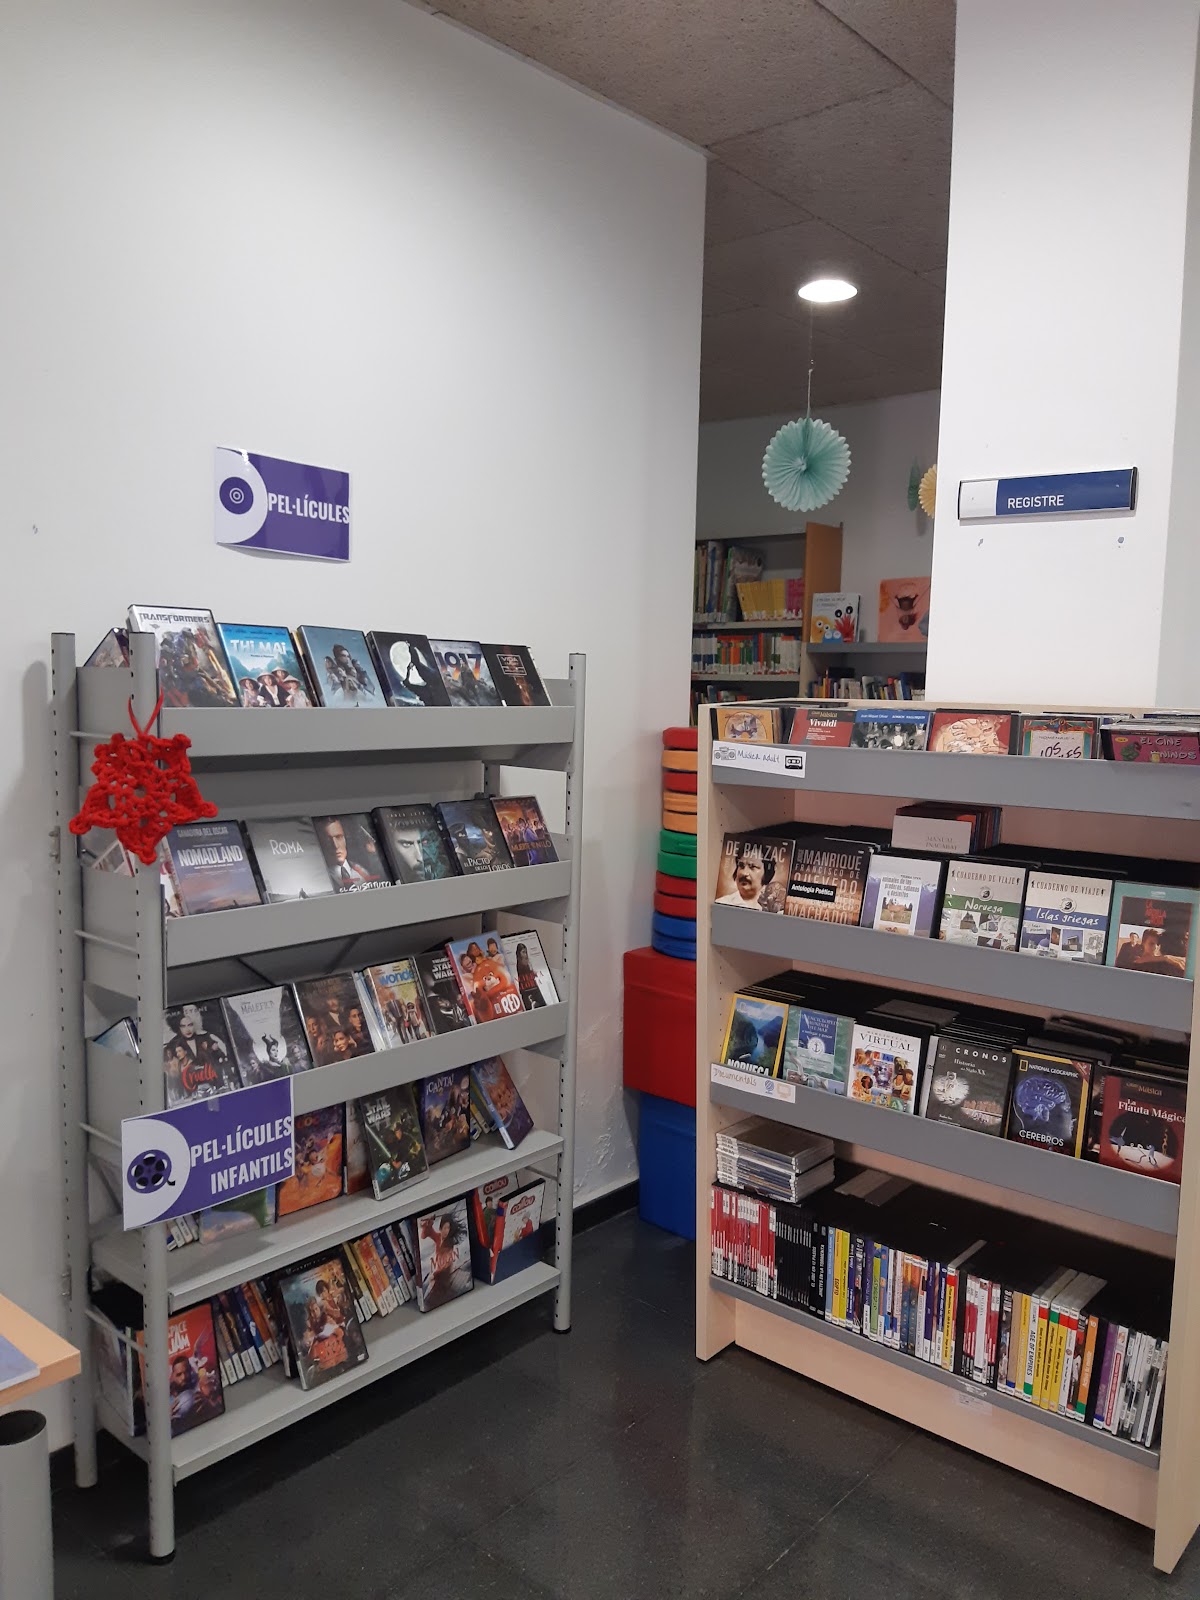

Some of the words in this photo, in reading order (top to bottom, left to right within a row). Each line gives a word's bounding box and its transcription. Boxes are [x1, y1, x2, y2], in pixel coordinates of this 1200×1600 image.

[267, 492, 349, 524] PEL·LÍCULES
[1007, 494, 1065, 509] REGISTRE
[138, 612, 210, 624] TRANSFORMERS
[434, 651, 482, 681] 1917
[810, 718, 837, 728] Vivaldi
[1140, 737, 1152, 745] EL
[1155, 737, 1181, 746] CINE
[269, 839, 305, 855] ROMA
[725, 840, 740, 857] DE
[743, 842, 787, 863] BALZAC
[177, 845, 243, 867] NOMADLAND
[467, 857, 490, 867] PACTO
[803, 849, 862, 871] MANRIQUE
[488, 863, 511, 872] LOBOS
[795, 863, 844, 877] FRANCISCO
[850, 870, 861, 879] DE
[956, 870, 986, 882] CUADERNO
[988, 875, 997, 883] DE
[998, 876, 1015, 885] VIAJE
[1036, 880, 1068, 893] CUADERNO
[1070, 885, 1079, 894] DE
[1081, 886, 1100, 896] VIAJE
[788, 903, 847, 924] MACHADO
[964, 899, 1003, 914] Noruega
[1036, 907, 1059, 922] Islas
[1062, 912, 1100, 926] griegas
[433, 970, 455, 979] WAR
[501, 993, 520, 1014] RED
[860, 1033, 914, 1052] VIRTUAL
[954, 1058, 976, 1067] Historia
[955, 1047, 1007, 1063] CRONOS
[182, 1063, 218, 1091] Cruella
[1029, 1064, 1051, 1073] NATIONAL
[1051, 1067, 1079, 1079] GEOGRAPHIC
[367, 1107, 392, 1124] WARS
[1118, 1100, 1149, 1116] Flauta
[190, 1115, 293, 1168] PEL·LÍCULES
[1018, 1130, 1065, 1147] CEREBROS
[210, 1147, 293, 1195] INFANTILS
[484, 1176, 508, 1195] caillou
[511, 1195, 536, 1215] caillou
[1027, 1348, 1035, 1376] EMPIRES
